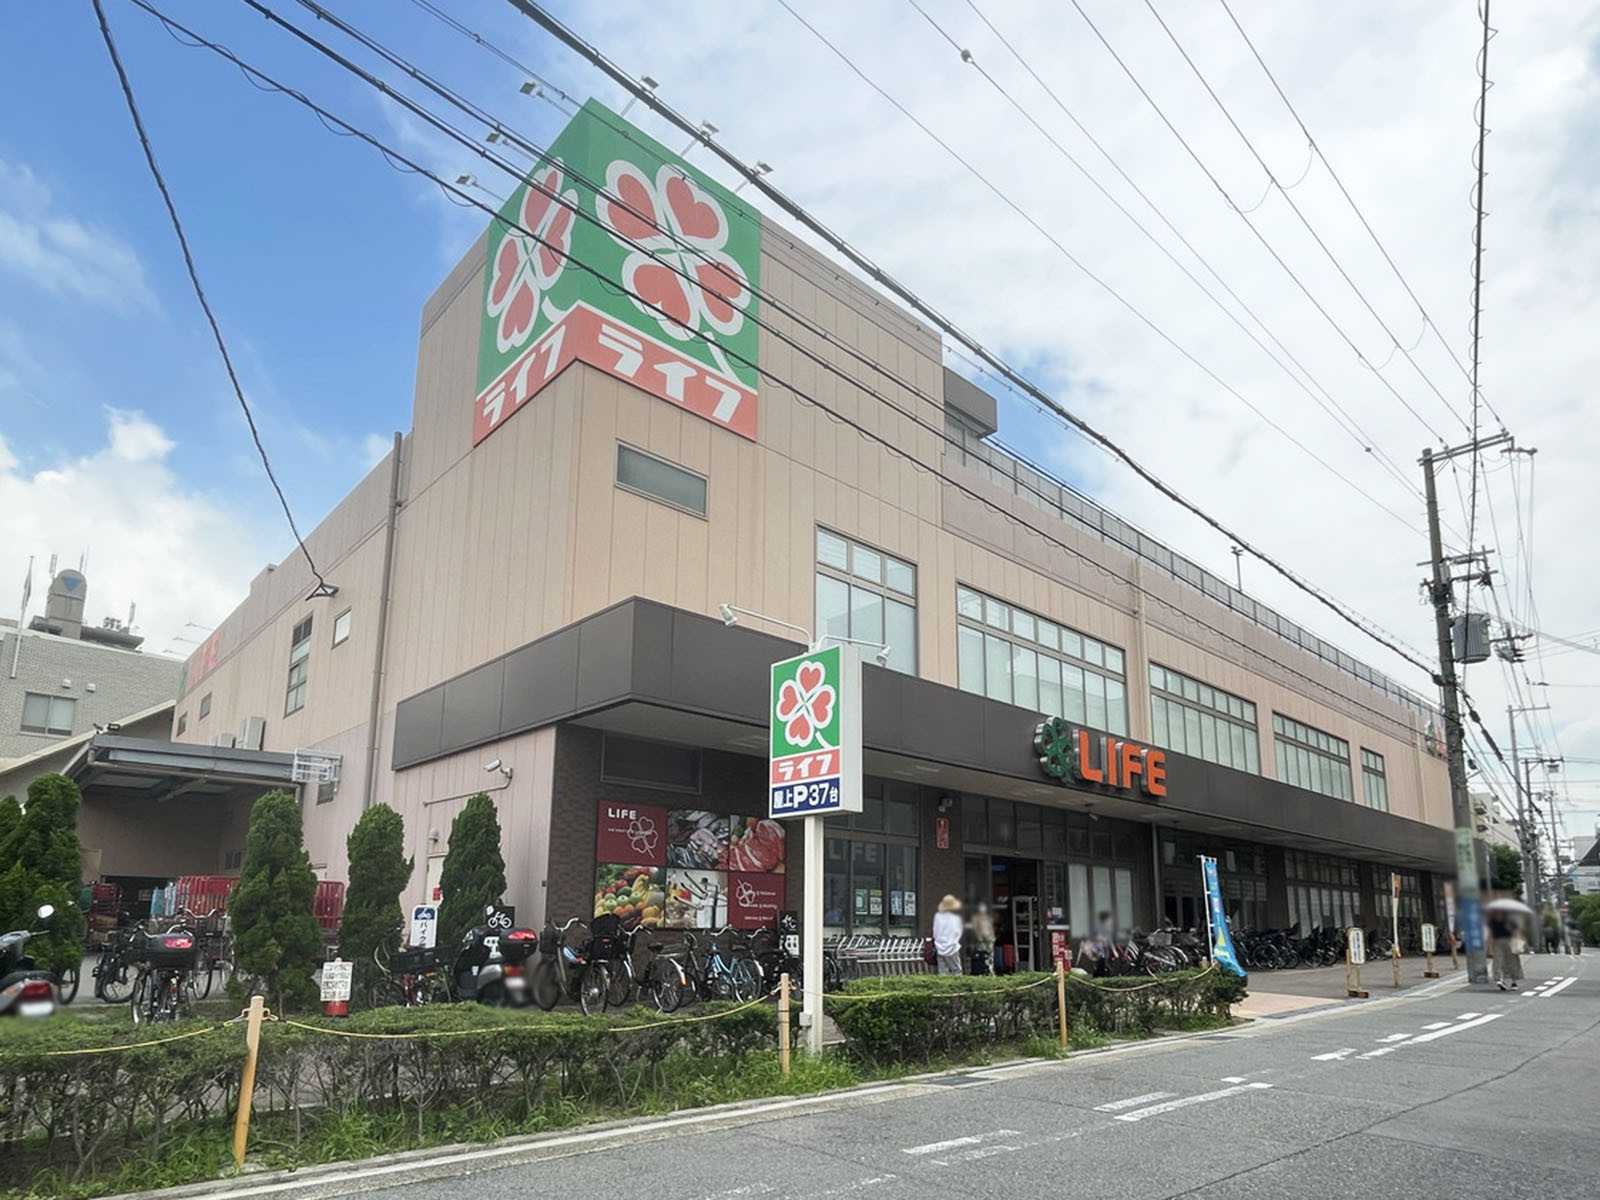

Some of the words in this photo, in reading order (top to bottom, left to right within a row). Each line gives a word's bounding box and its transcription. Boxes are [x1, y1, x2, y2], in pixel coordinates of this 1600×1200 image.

[483, 324, 566, 427] ライフ
[598, 323, 742, 423] ライフ
[778, 754, 832, 781] ライフ
[1079, 730, 1167, 797] LIFE
[607, 807, 637, 820] LIFE
